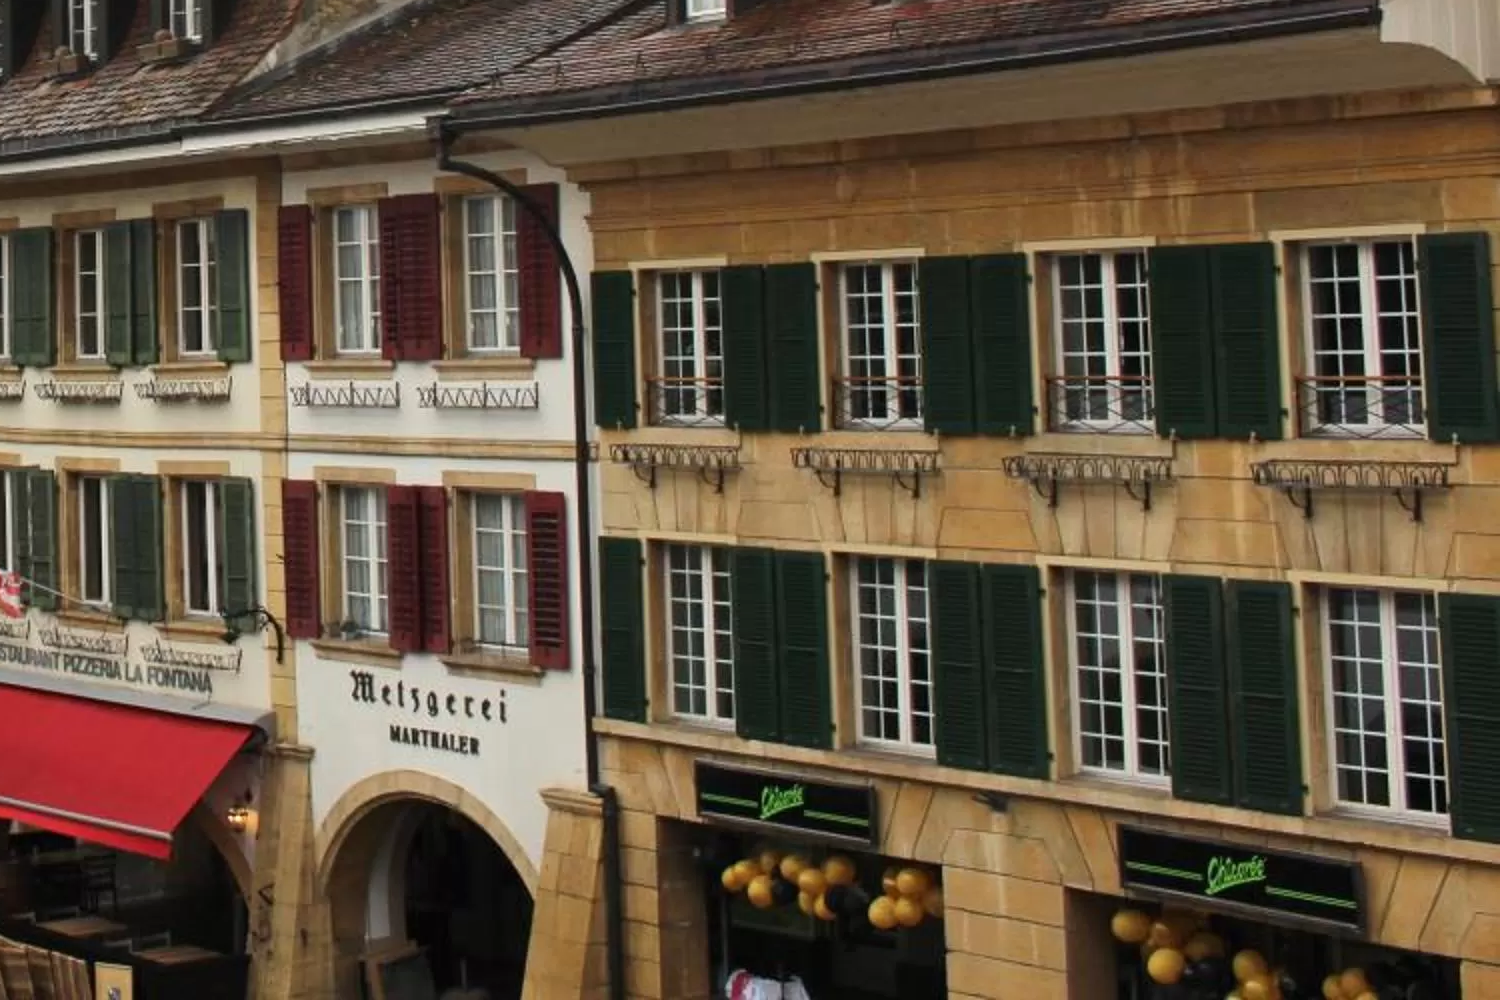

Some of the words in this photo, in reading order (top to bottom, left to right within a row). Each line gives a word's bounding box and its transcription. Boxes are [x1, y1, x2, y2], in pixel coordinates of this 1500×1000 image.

[63, 654, 122, 681] PIZZERIA
[125, 662, 143, 684] LA
[147, 666, 214, 694] FONTANA
[350, 669, 507, 724] Metzgerei
[389, 724, 481, 756] MARTHALER
